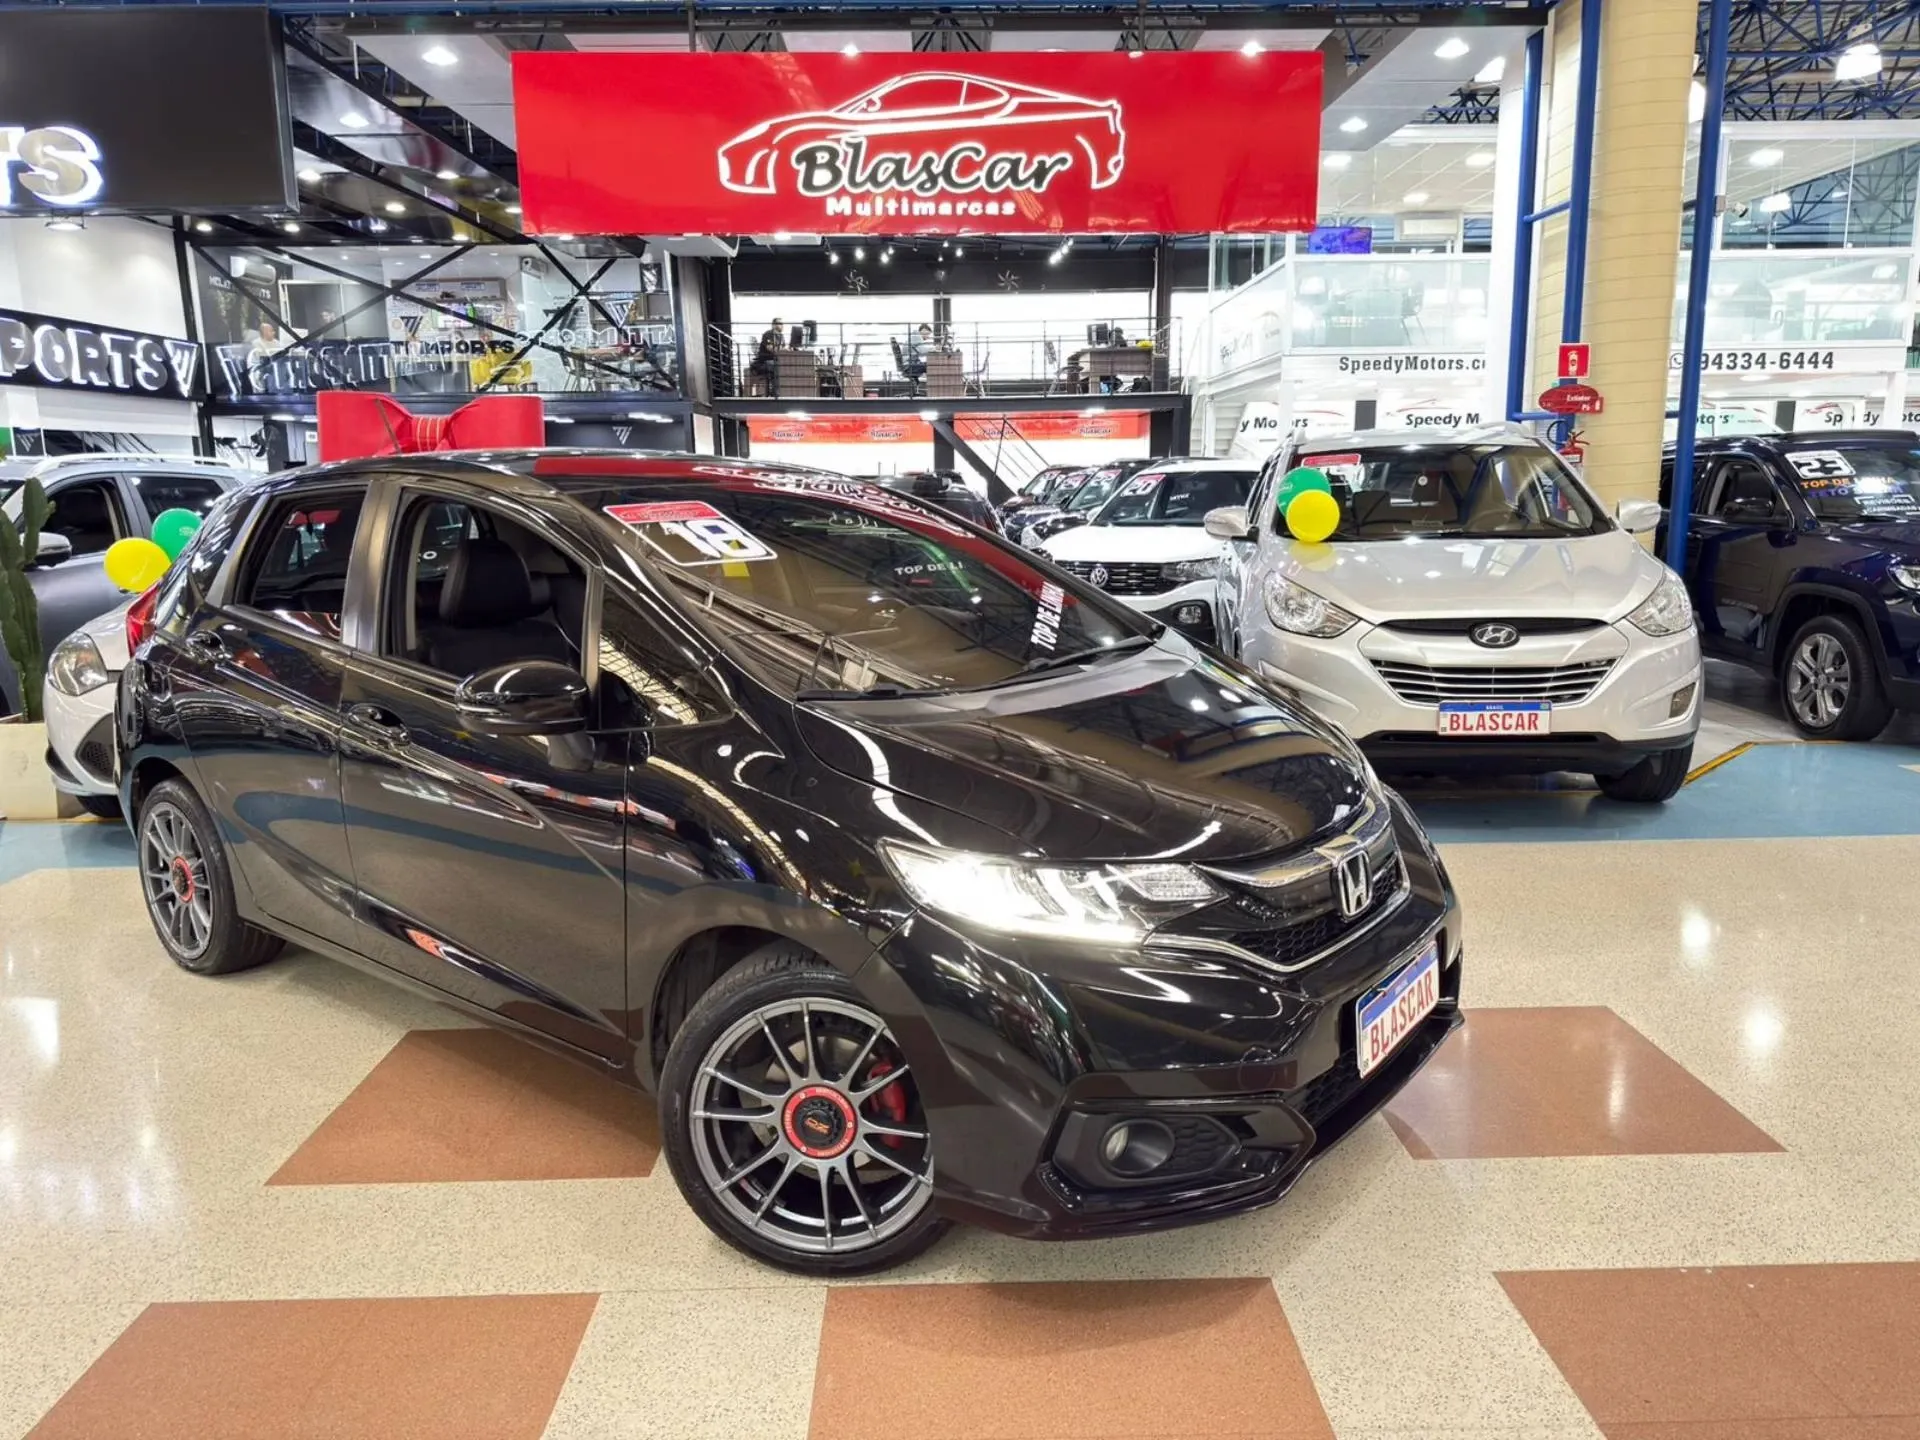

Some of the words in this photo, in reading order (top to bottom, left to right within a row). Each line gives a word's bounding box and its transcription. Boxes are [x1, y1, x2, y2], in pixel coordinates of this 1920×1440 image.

[792, 138, 1072, 196] BlasCar
[826, 198, 1016, 216] Multimarcas
[0, 317, 169, 391] PORTS
[1253, 417, 1309, 429] Mors
[1405, 413, 1462, 428] Speedy
[1824, 411, 1880, 427] Spdy
[1801, 479, 1829, 489] TOP
[894, 565, 923, 576] TOP
[1450, 712, 1539, 732] BLASCAR
[1370, 969, 1434, 1063] BLASCAR
